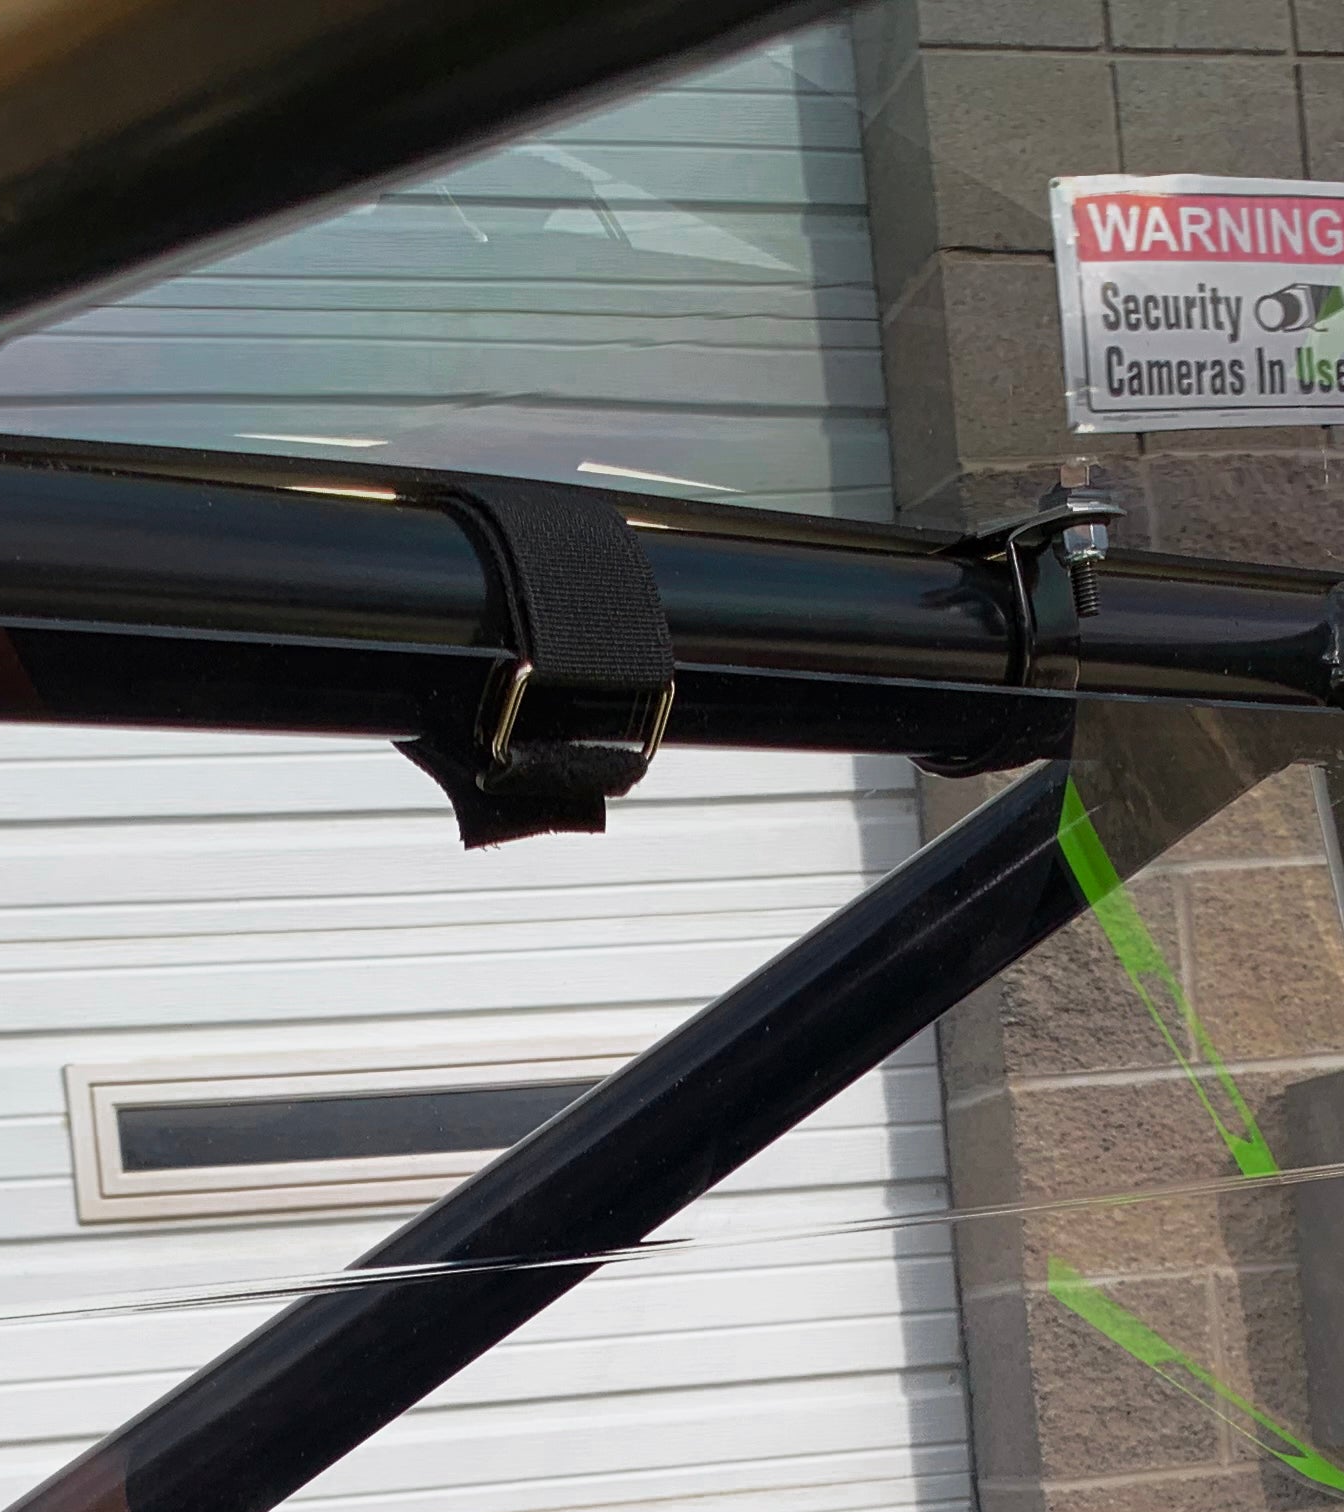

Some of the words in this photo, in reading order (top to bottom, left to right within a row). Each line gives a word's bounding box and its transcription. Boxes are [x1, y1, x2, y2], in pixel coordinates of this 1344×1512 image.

[1086, 203, 1344, 257] WARNING
[1102, 282, 1243, 342] Security
[1105, 346, 1246, 398] Cameras
[1257, 348, 1287, 396] In
